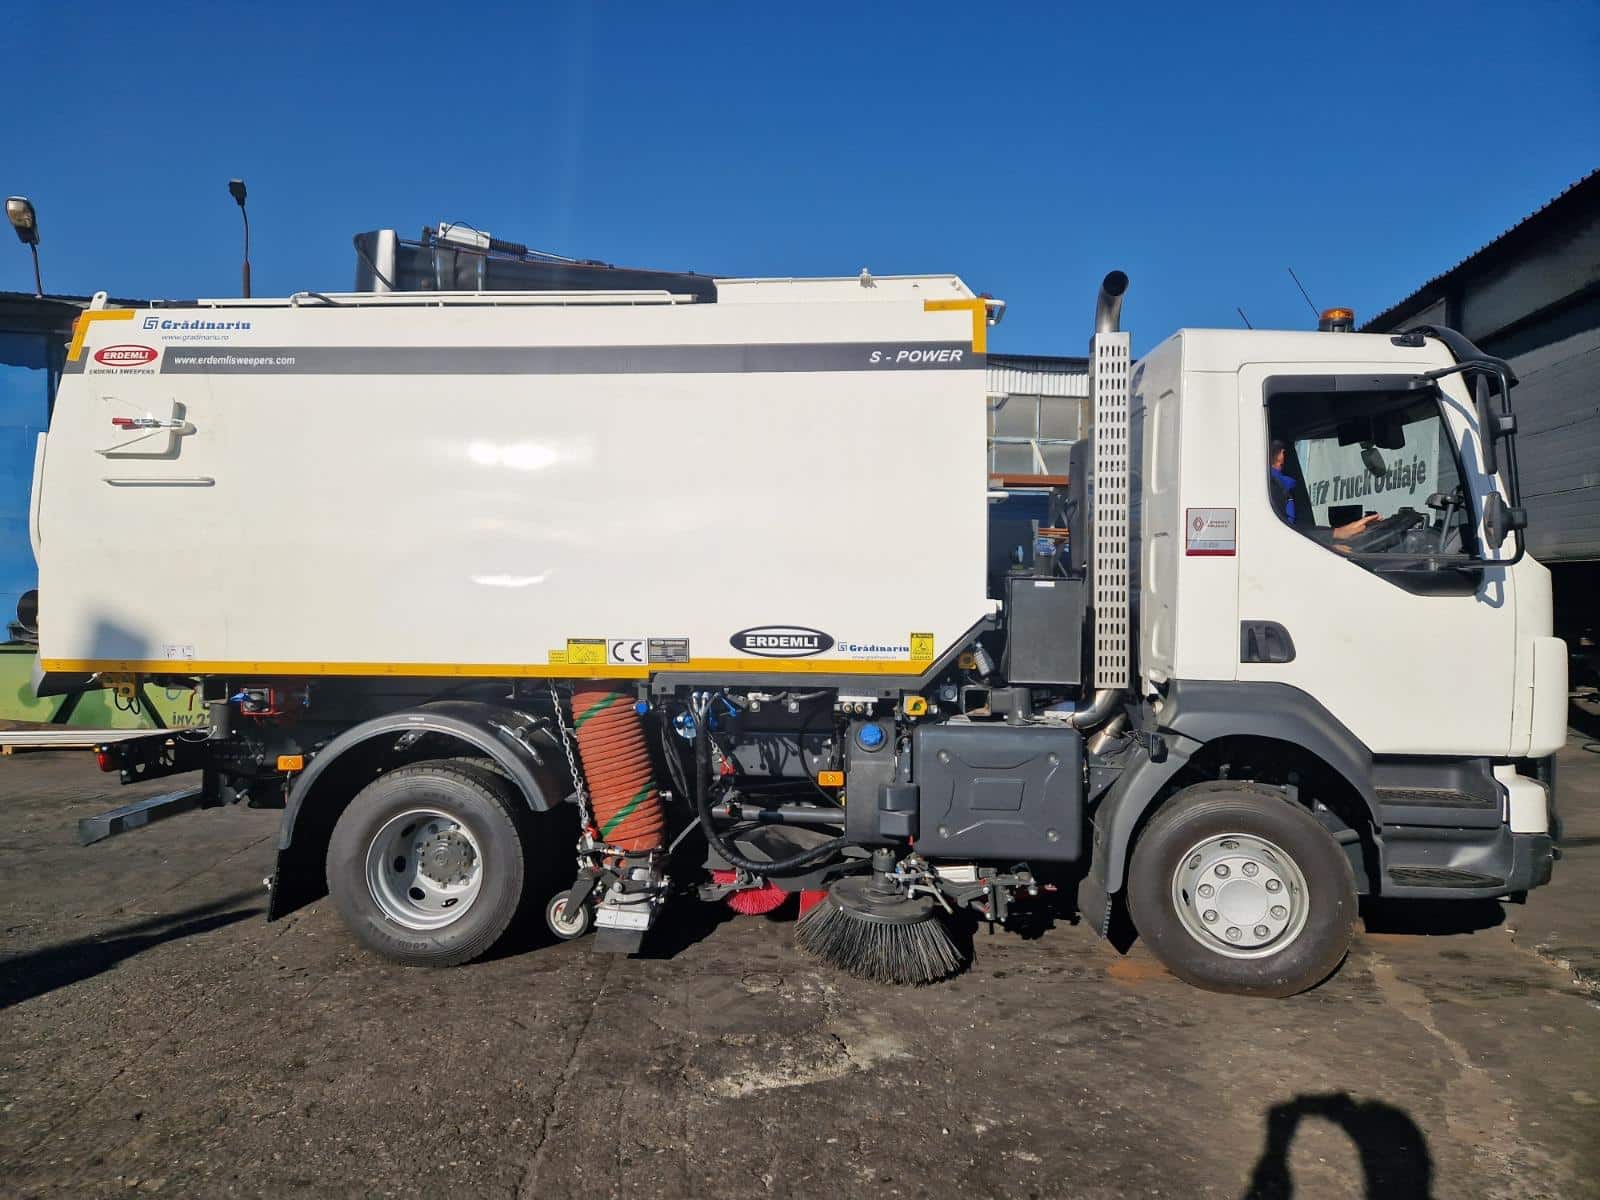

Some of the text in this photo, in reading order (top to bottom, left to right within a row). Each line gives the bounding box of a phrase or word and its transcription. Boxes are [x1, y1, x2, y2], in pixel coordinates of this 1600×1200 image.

[103, 351, 149, 360] ERDEMLI
[174, 355, 296, 366] www.erdemlisweepers.com
[869, 351, 882, 363] S
[896, 350, 963, 363] POWER
[1333, 469, 1371, 501] Truck
[745, 635, 818, 648] ERDEMLI
